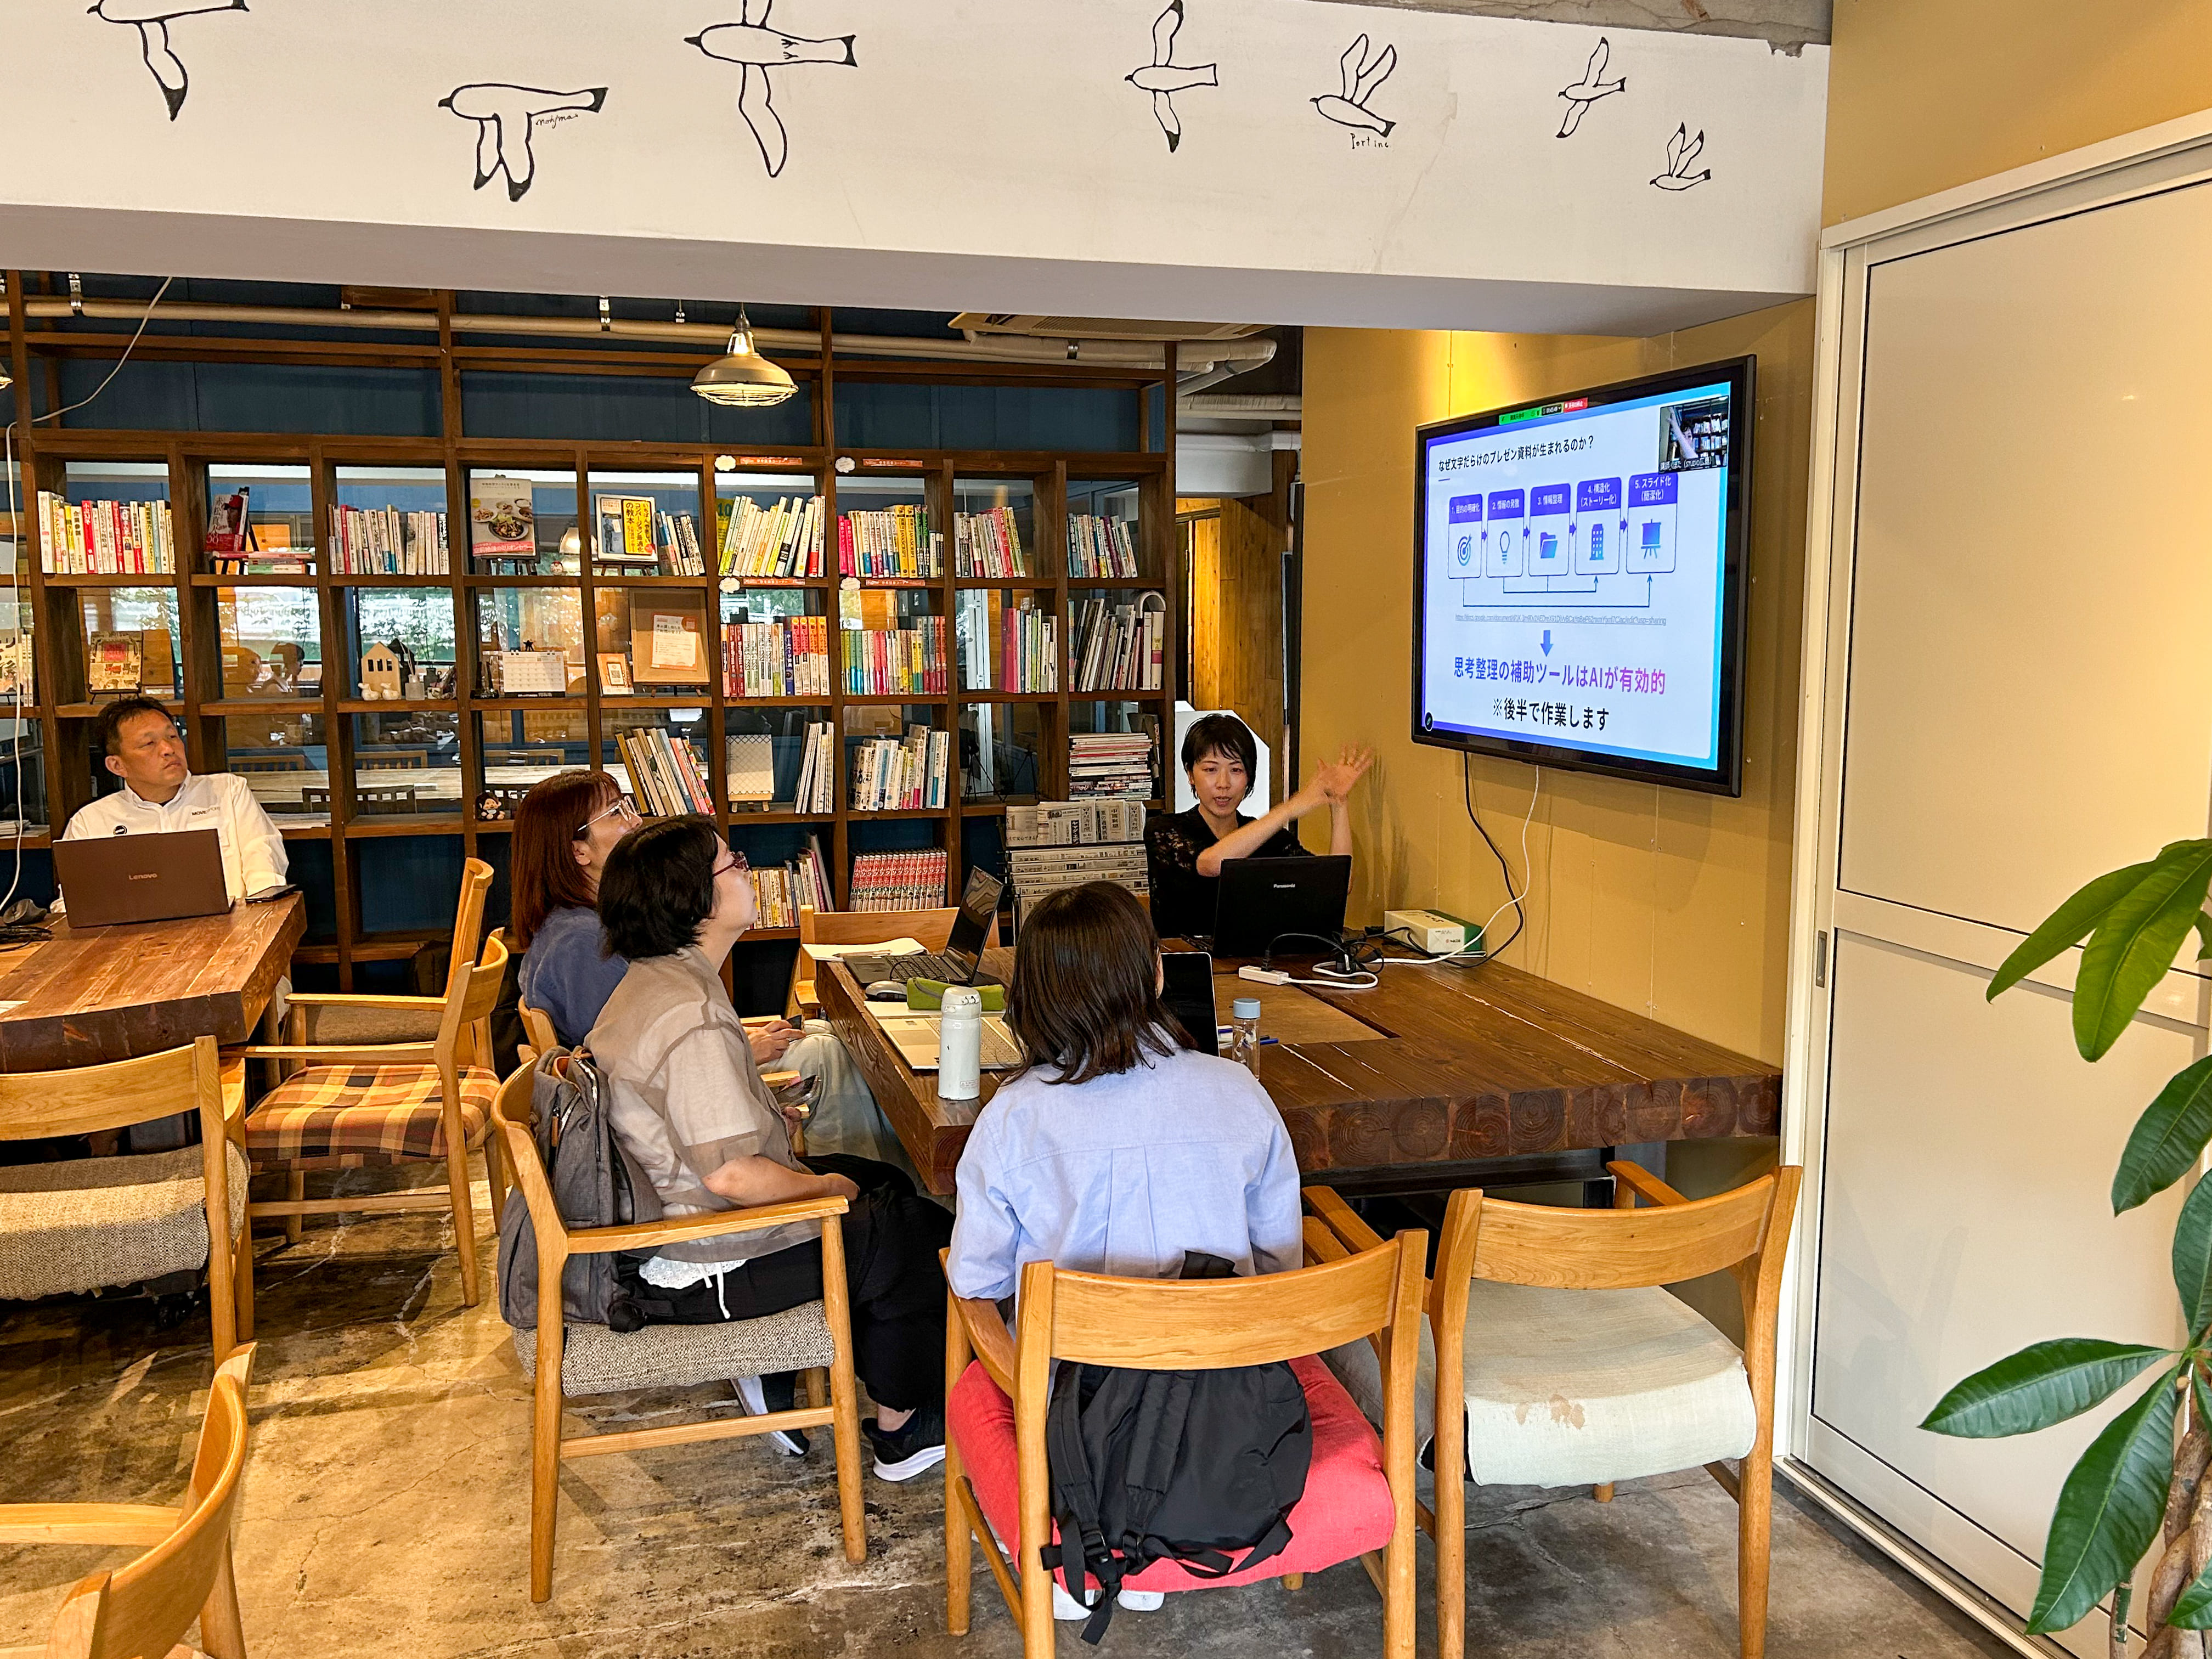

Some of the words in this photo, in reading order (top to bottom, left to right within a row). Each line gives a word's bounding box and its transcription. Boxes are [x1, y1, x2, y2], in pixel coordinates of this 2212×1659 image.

[1350, 133, 1370, 149] Port
[1438, 435, 1594, 472] なぜ文字だらけのプレゼン資料が生まれるのか？
[1641, 475, 1672, 489] スライド化
[1543, 493, 1563, 505] 情報整理
[625, 502, 634, 524] の教本
[1454, 656, 1666, 695] 思考整理の補助ツールはAIが有効的
[1493, 697, 1609, 731] ※後半で作業します
